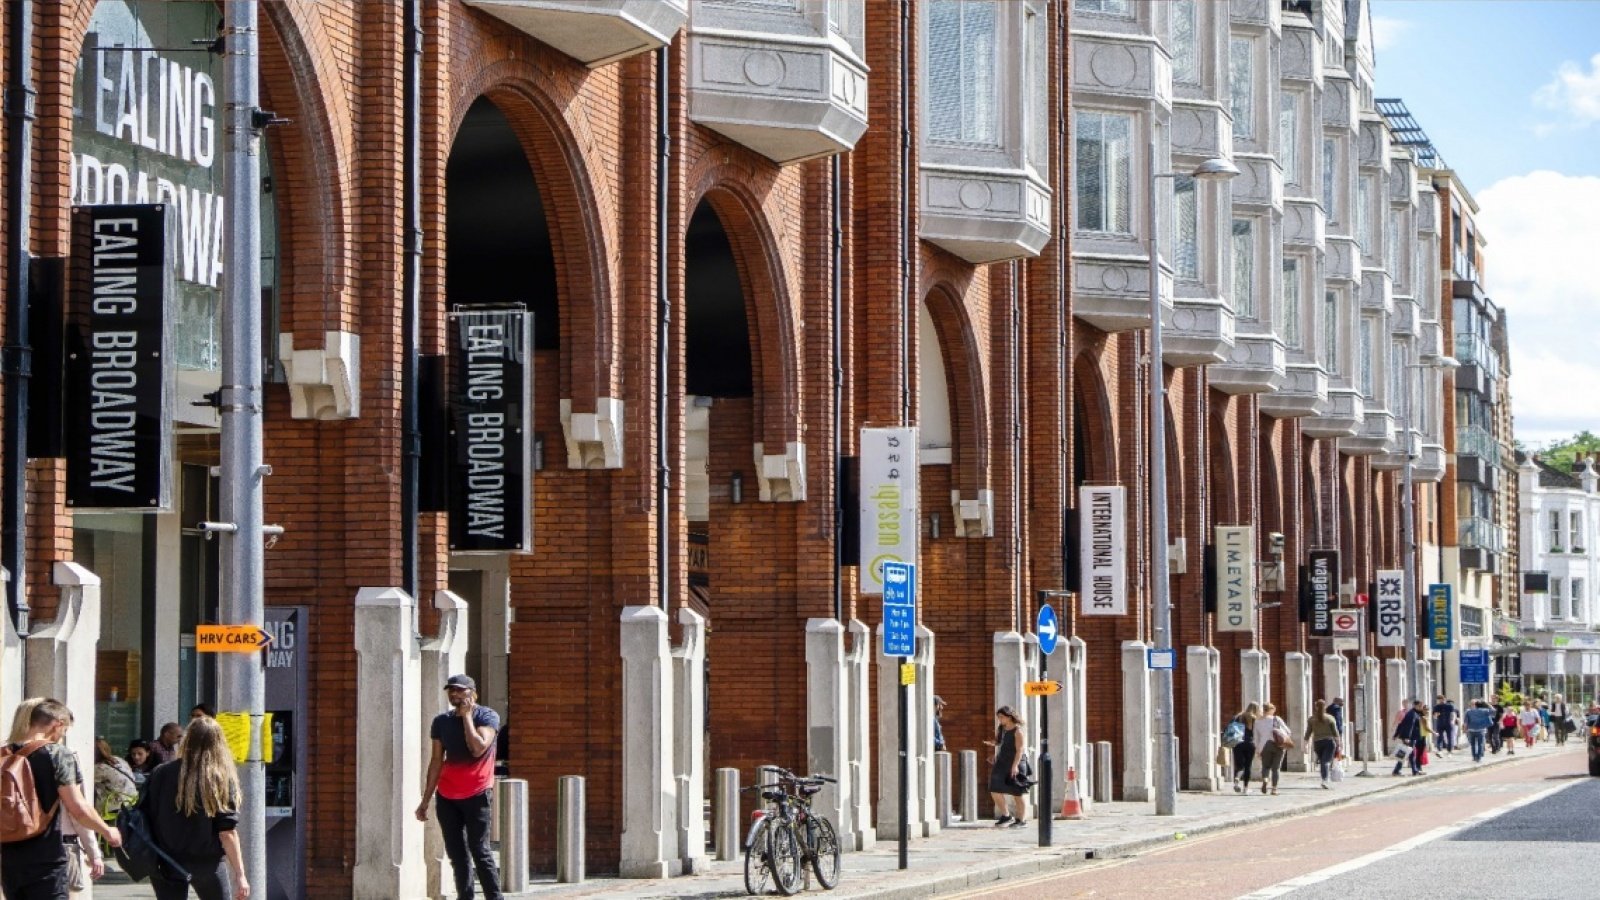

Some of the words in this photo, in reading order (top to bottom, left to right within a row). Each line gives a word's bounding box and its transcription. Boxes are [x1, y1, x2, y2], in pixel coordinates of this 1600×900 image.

[96, 42, 216, 169] EALING
[93, 217, 139, 315] EALING
[467, 323, 504, 401] EALING
[90, 330, 138, 493] BROADWAY
[467, 412, 504, 539] BROADWAY
[870, 484, 900, 546] wasabi
[1092, 492, 1113, 570] INTERNATIONAL
[1093, 575, 1113, 609] HOUSE
[1226, 531, 1243, 626] LIMEYARD
[1311, 557, 1329, 631] wagamama
[200, 632, 224, 645] HRV
[226, 632, 257, 645] CARS
[1380, 600, 1401, 638] RBS
